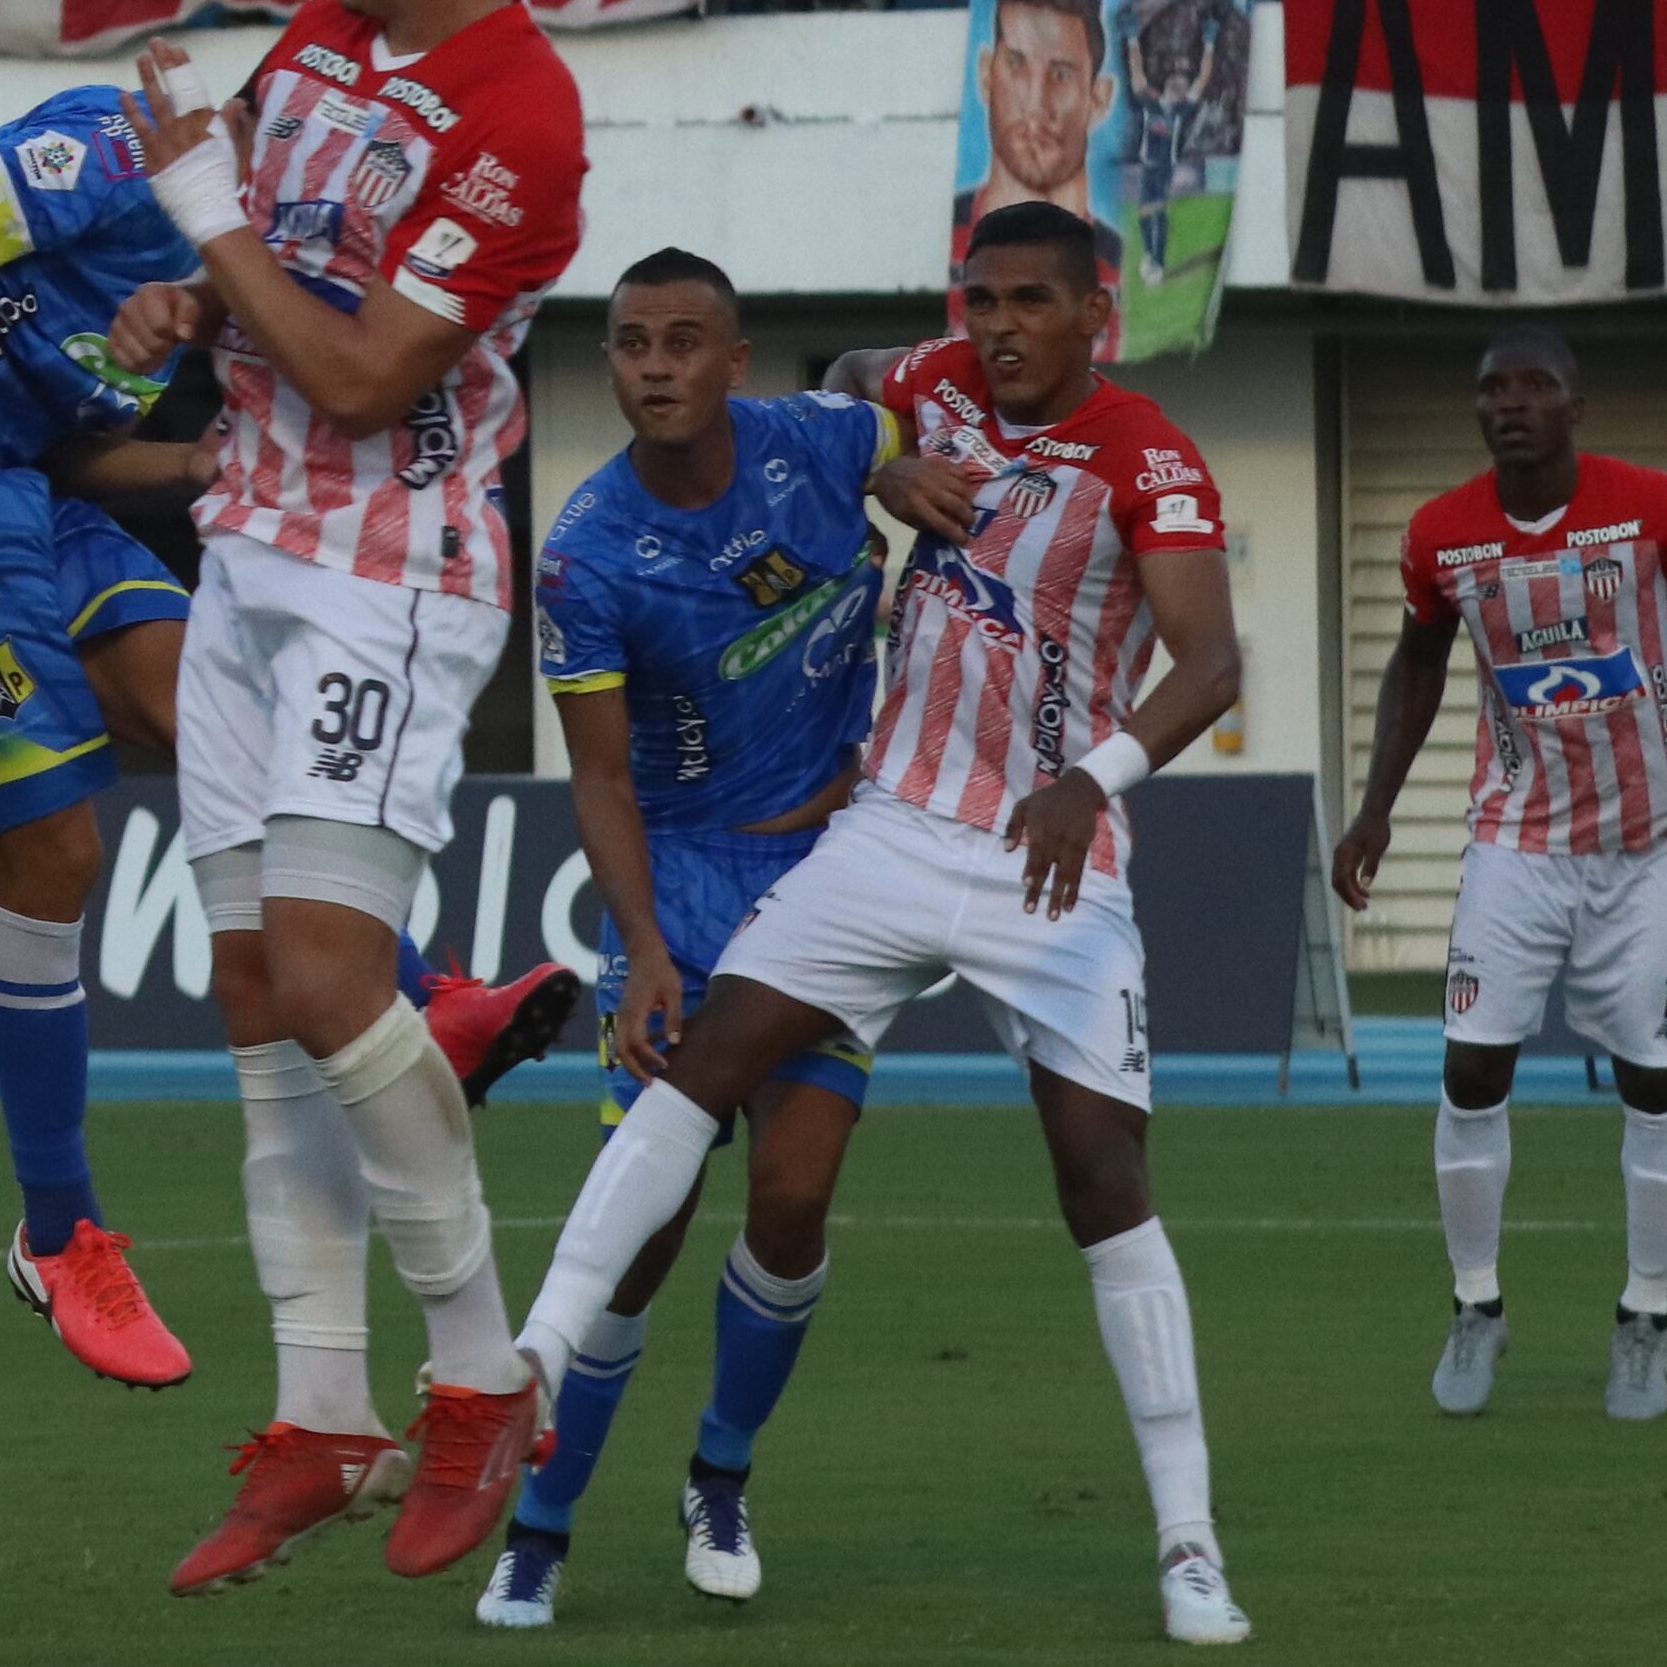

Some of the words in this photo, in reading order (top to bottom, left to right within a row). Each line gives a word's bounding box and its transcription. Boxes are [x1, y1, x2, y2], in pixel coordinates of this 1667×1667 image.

[1566, 520, 1641, 548] POSTOBON
[1436, 542, 1505, 566] POSTOBON
[1521, 618, 1585, 652] AGUILA
[311, 671, 391, 751] 30
